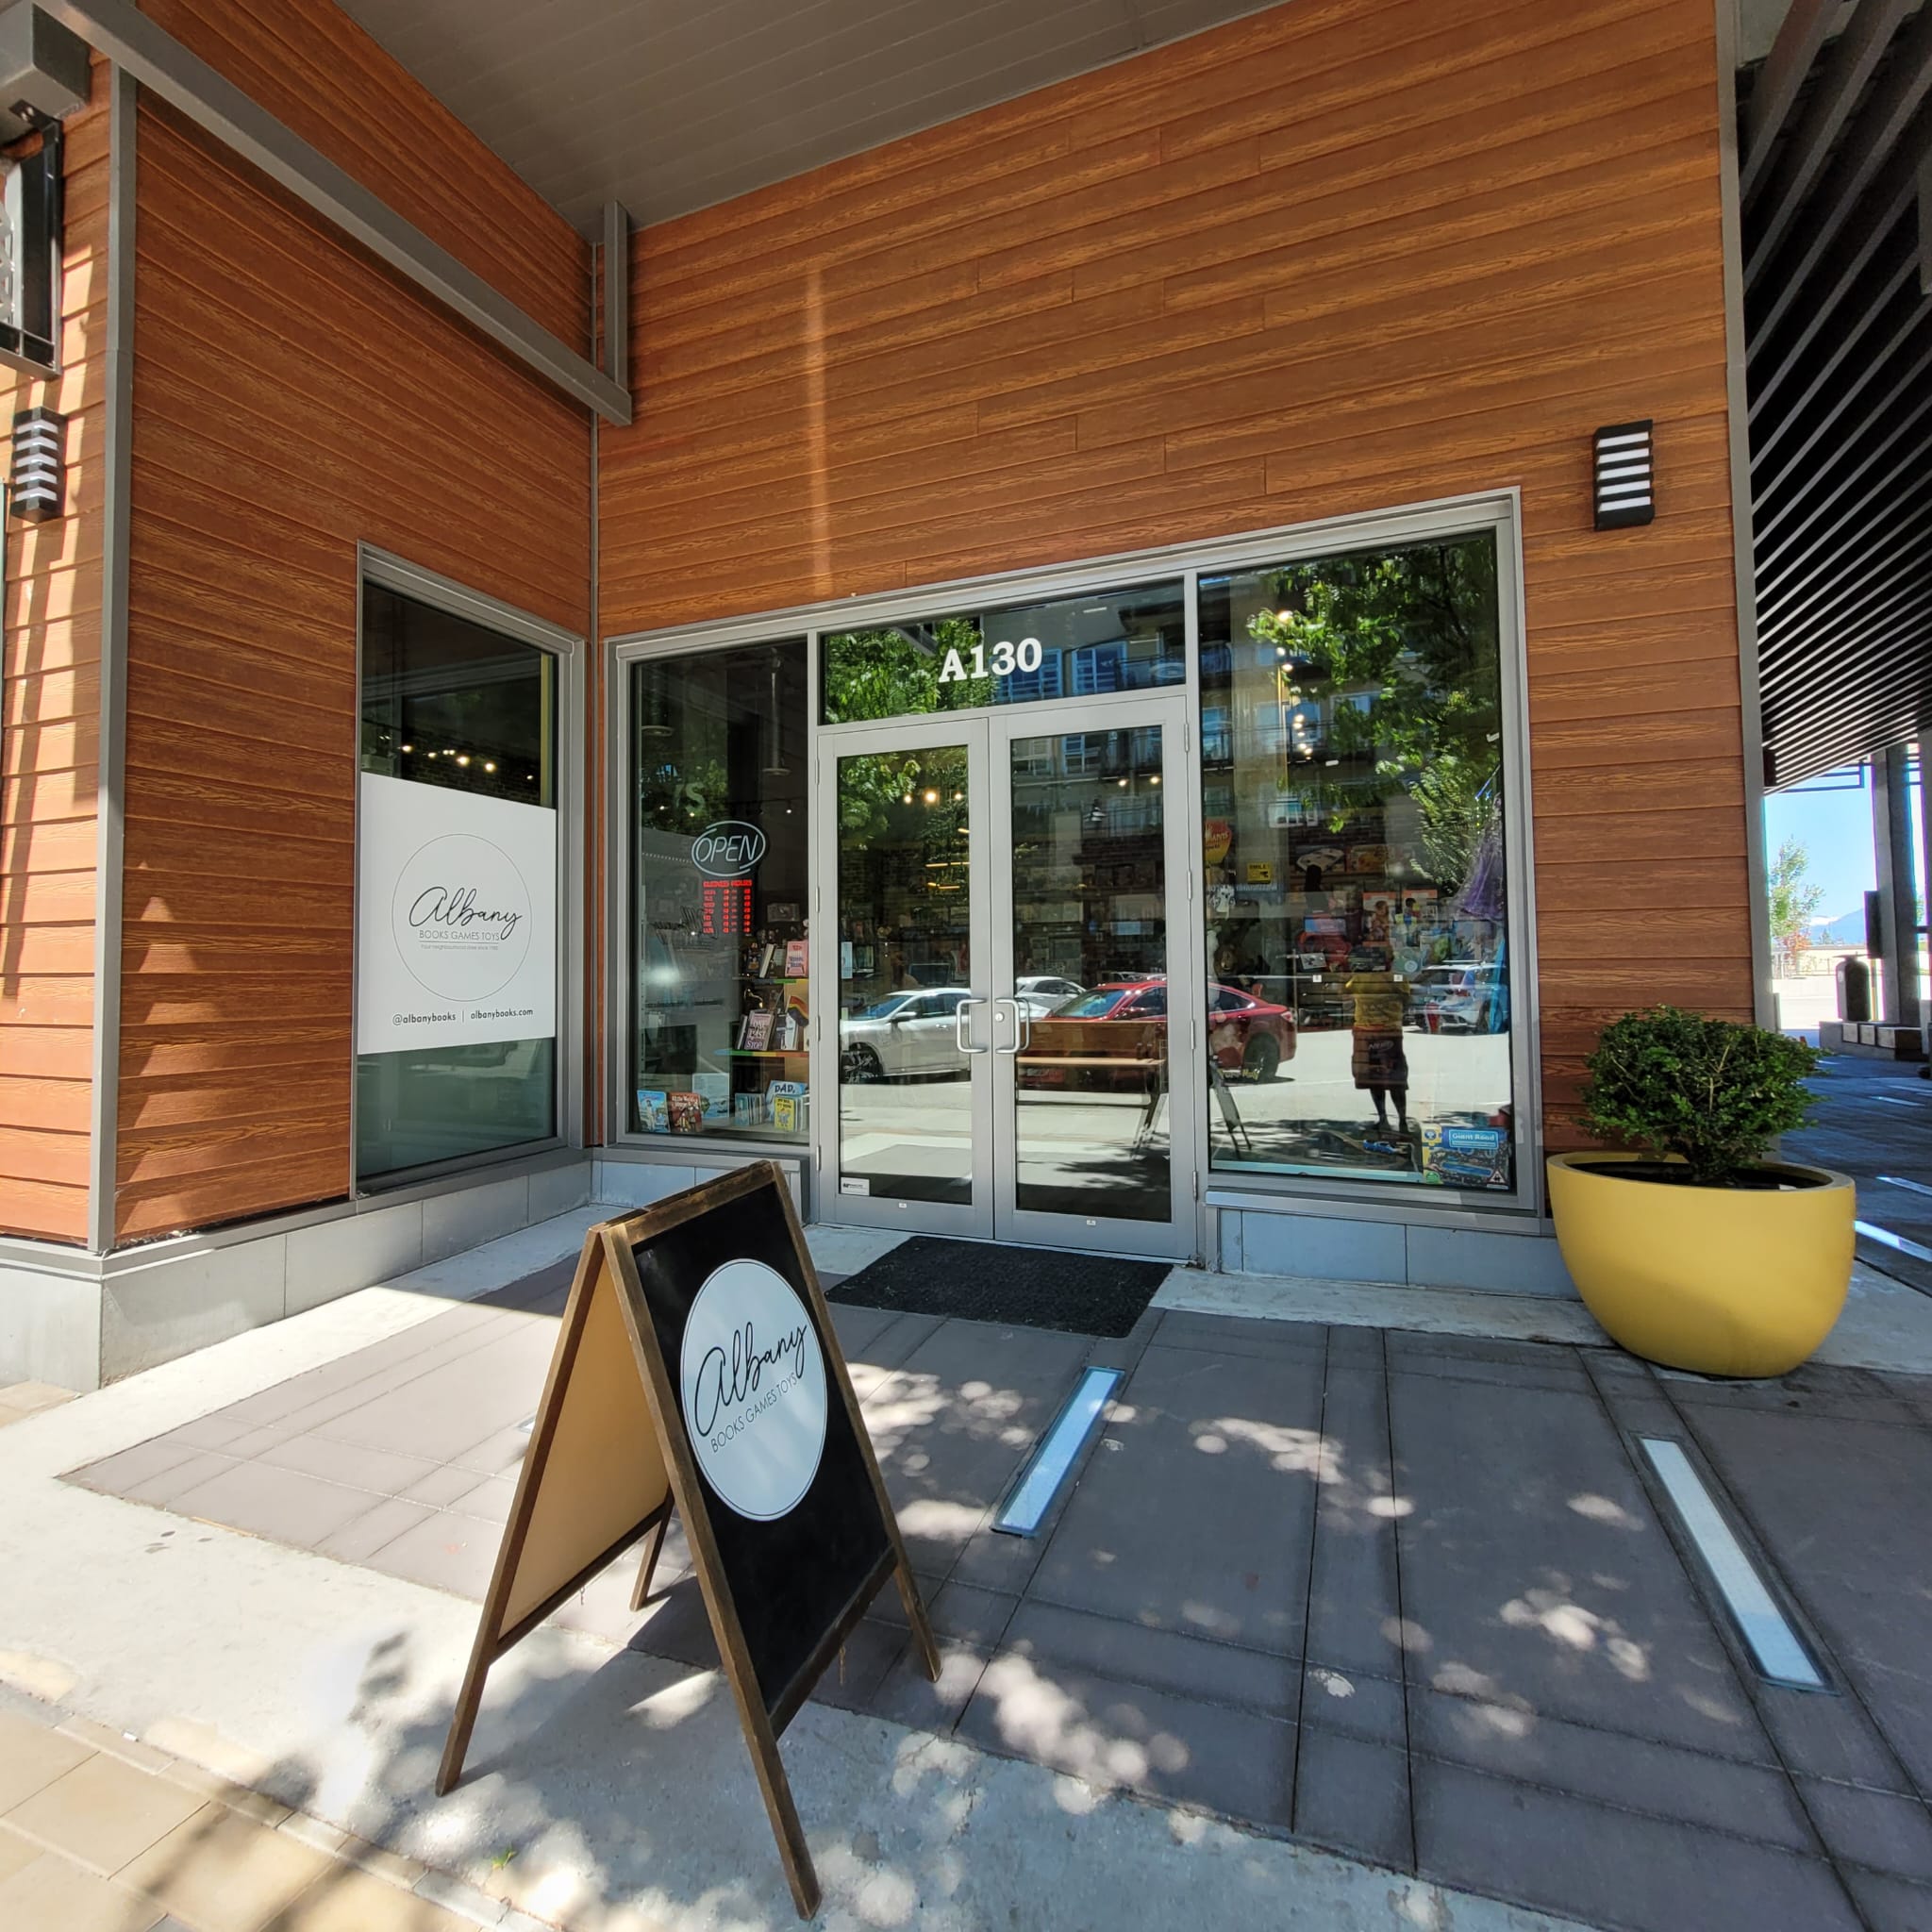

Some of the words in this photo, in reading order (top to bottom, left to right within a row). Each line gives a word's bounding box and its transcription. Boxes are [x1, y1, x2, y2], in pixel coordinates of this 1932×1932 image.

[938, 637, 1043, 684] A130
[695, 834, 758, 863] OPEN
[408, 886, 523, 941] Albany
[419, 929, 448, 940] BOOKS
[451, 931, 479, 941] GAMES
[481, 932, 500, 941] TOYS
[392, 1012, 457, 1026] @albanybooks
[470, 1007, 534, 1020] albanybooks.com
[1452, 1132, 1474, 1141] Giant
[694, 1322, 808, 1437] Albany
[710, 1417, 745, 1454] BOOKS
[745, 1390, 777, 1424] GAMES
[777, 1372, 797, 1396] TOYS
